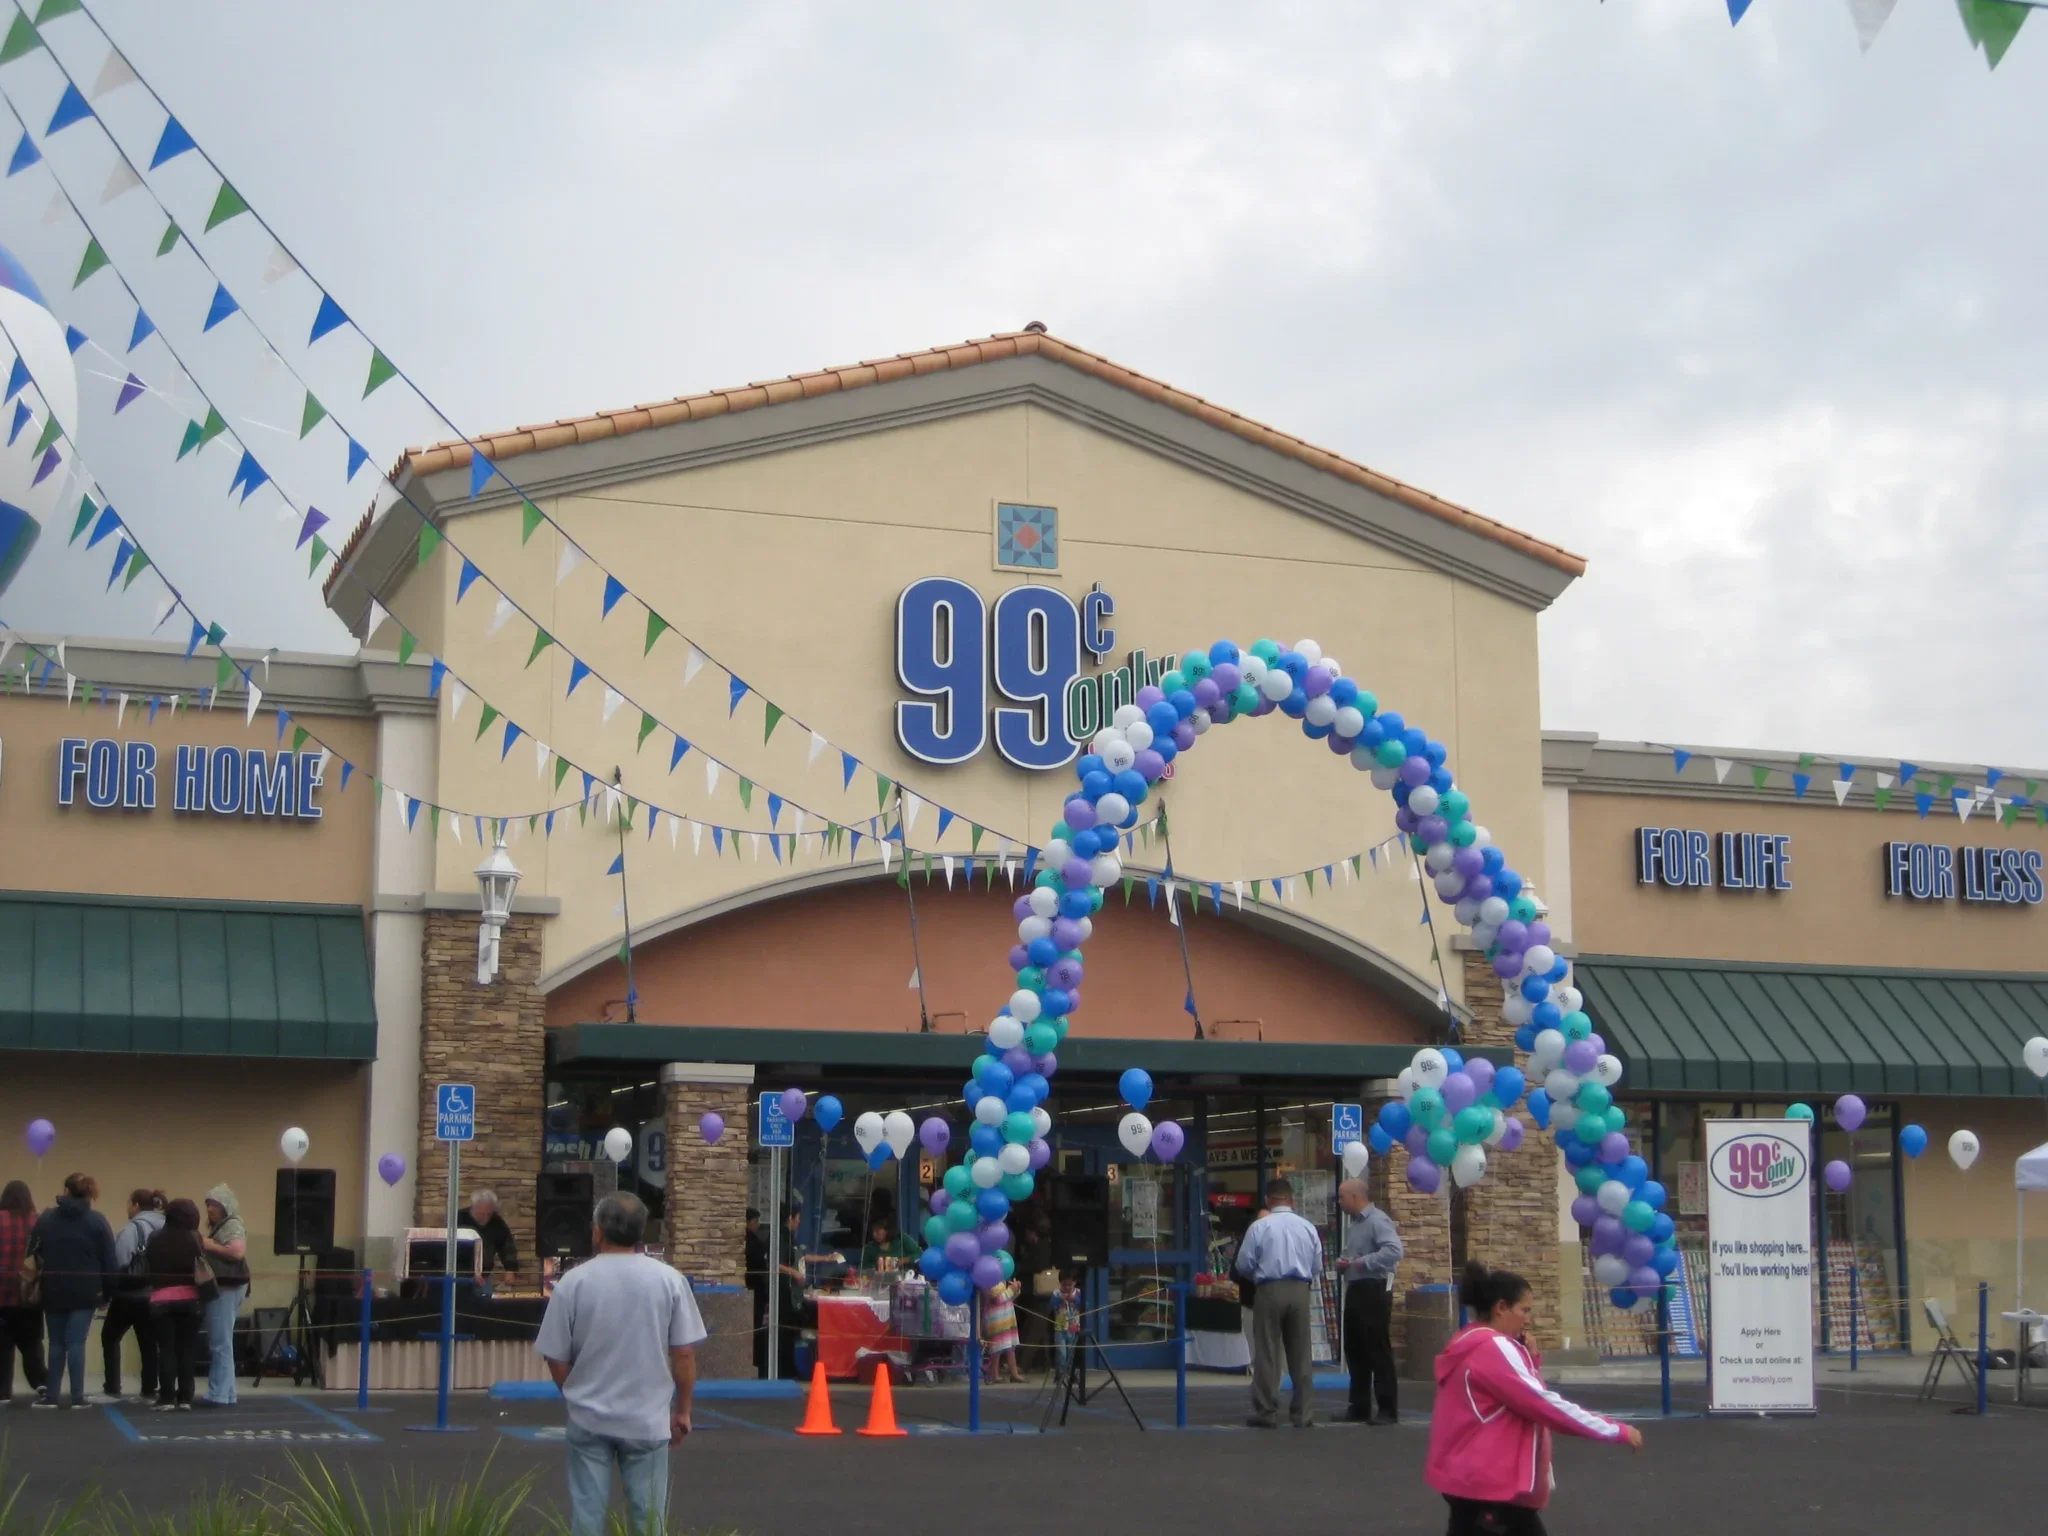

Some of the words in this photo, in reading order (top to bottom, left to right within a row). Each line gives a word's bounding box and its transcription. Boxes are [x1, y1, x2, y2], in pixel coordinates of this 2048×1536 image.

[58, 737, 156, 808] FOR
[174, 744, 324, 818] HOME
[1641, 827, 1711, 886] FOR
[1721, 832, 1792, 890] LIFE
[1888, 841, 1955, 898] FOR
[1962, 846, 2044, 904] LESS
[440, 1113, 471, 1124] PARKING
[445, 1126, 466, 1136] ONLY
[923, 1165, 931, 1179] 2
[1107, 1166, 1116, 1180] 3
[1768, 1156, 1795, 1181] only
[1712, 1241, 1718, 1253] If
[1719, 1243, 1733, 1256] you
[1735, 1241, 1747, 1253] like
[1750, 1241, 1784, 1257] shopping
[1743, 1264, 1758, 1276] love
[1760, 1264, 1789, 1279] working
[1741, 1328, 1762, 1337] Apply
[1764, 1328, 1781, 1336] Here
[1720, 1356, 1742, 1364] Check
[1755, 1356, 1767, 1364] out
[1769, 1355, 1791, 1364] online
